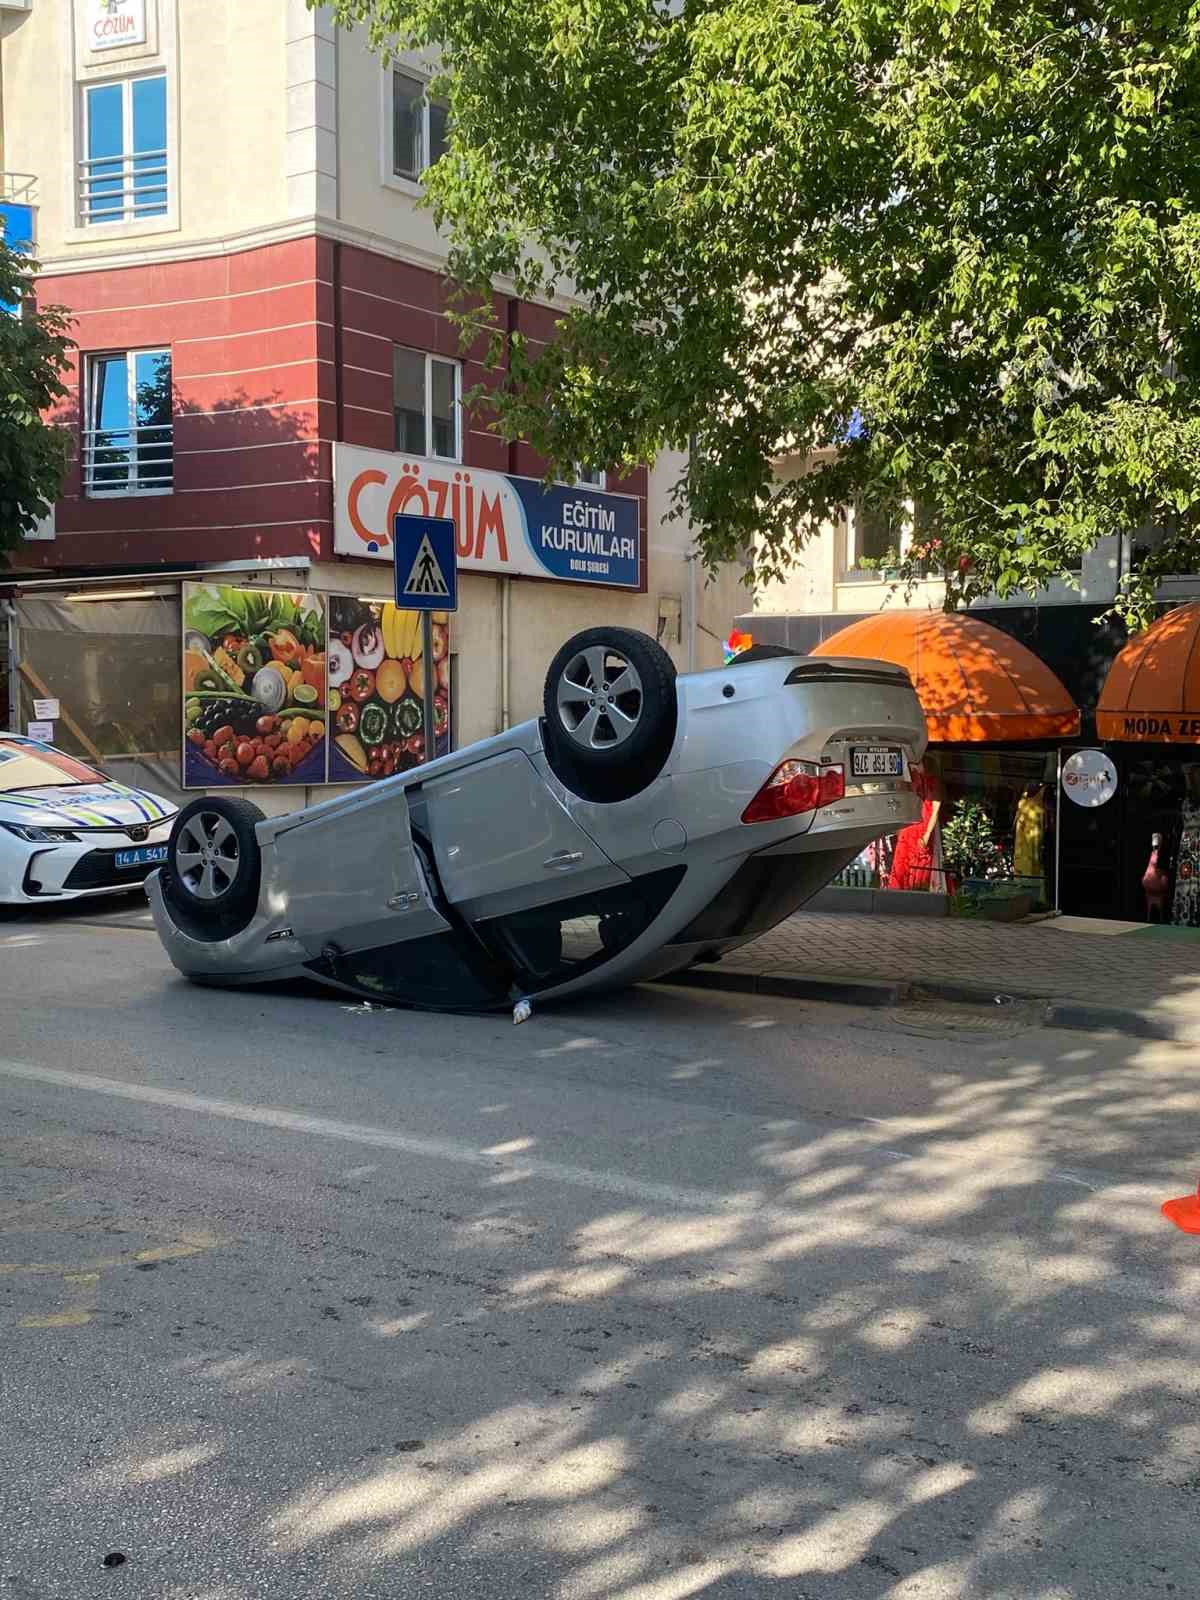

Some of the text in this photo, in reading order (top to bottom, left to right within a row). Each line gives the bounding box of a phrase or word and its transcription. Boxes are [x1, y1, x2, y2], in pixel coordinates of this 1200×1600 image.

[562, 500, 615, 532] EĞİTİM
[541, 525, 635, 560] KURUMLARI
[1123, 718, 1171, 736] MODA
[117, 852, 129, 865] 14
[133, 850, 141, 863] A
